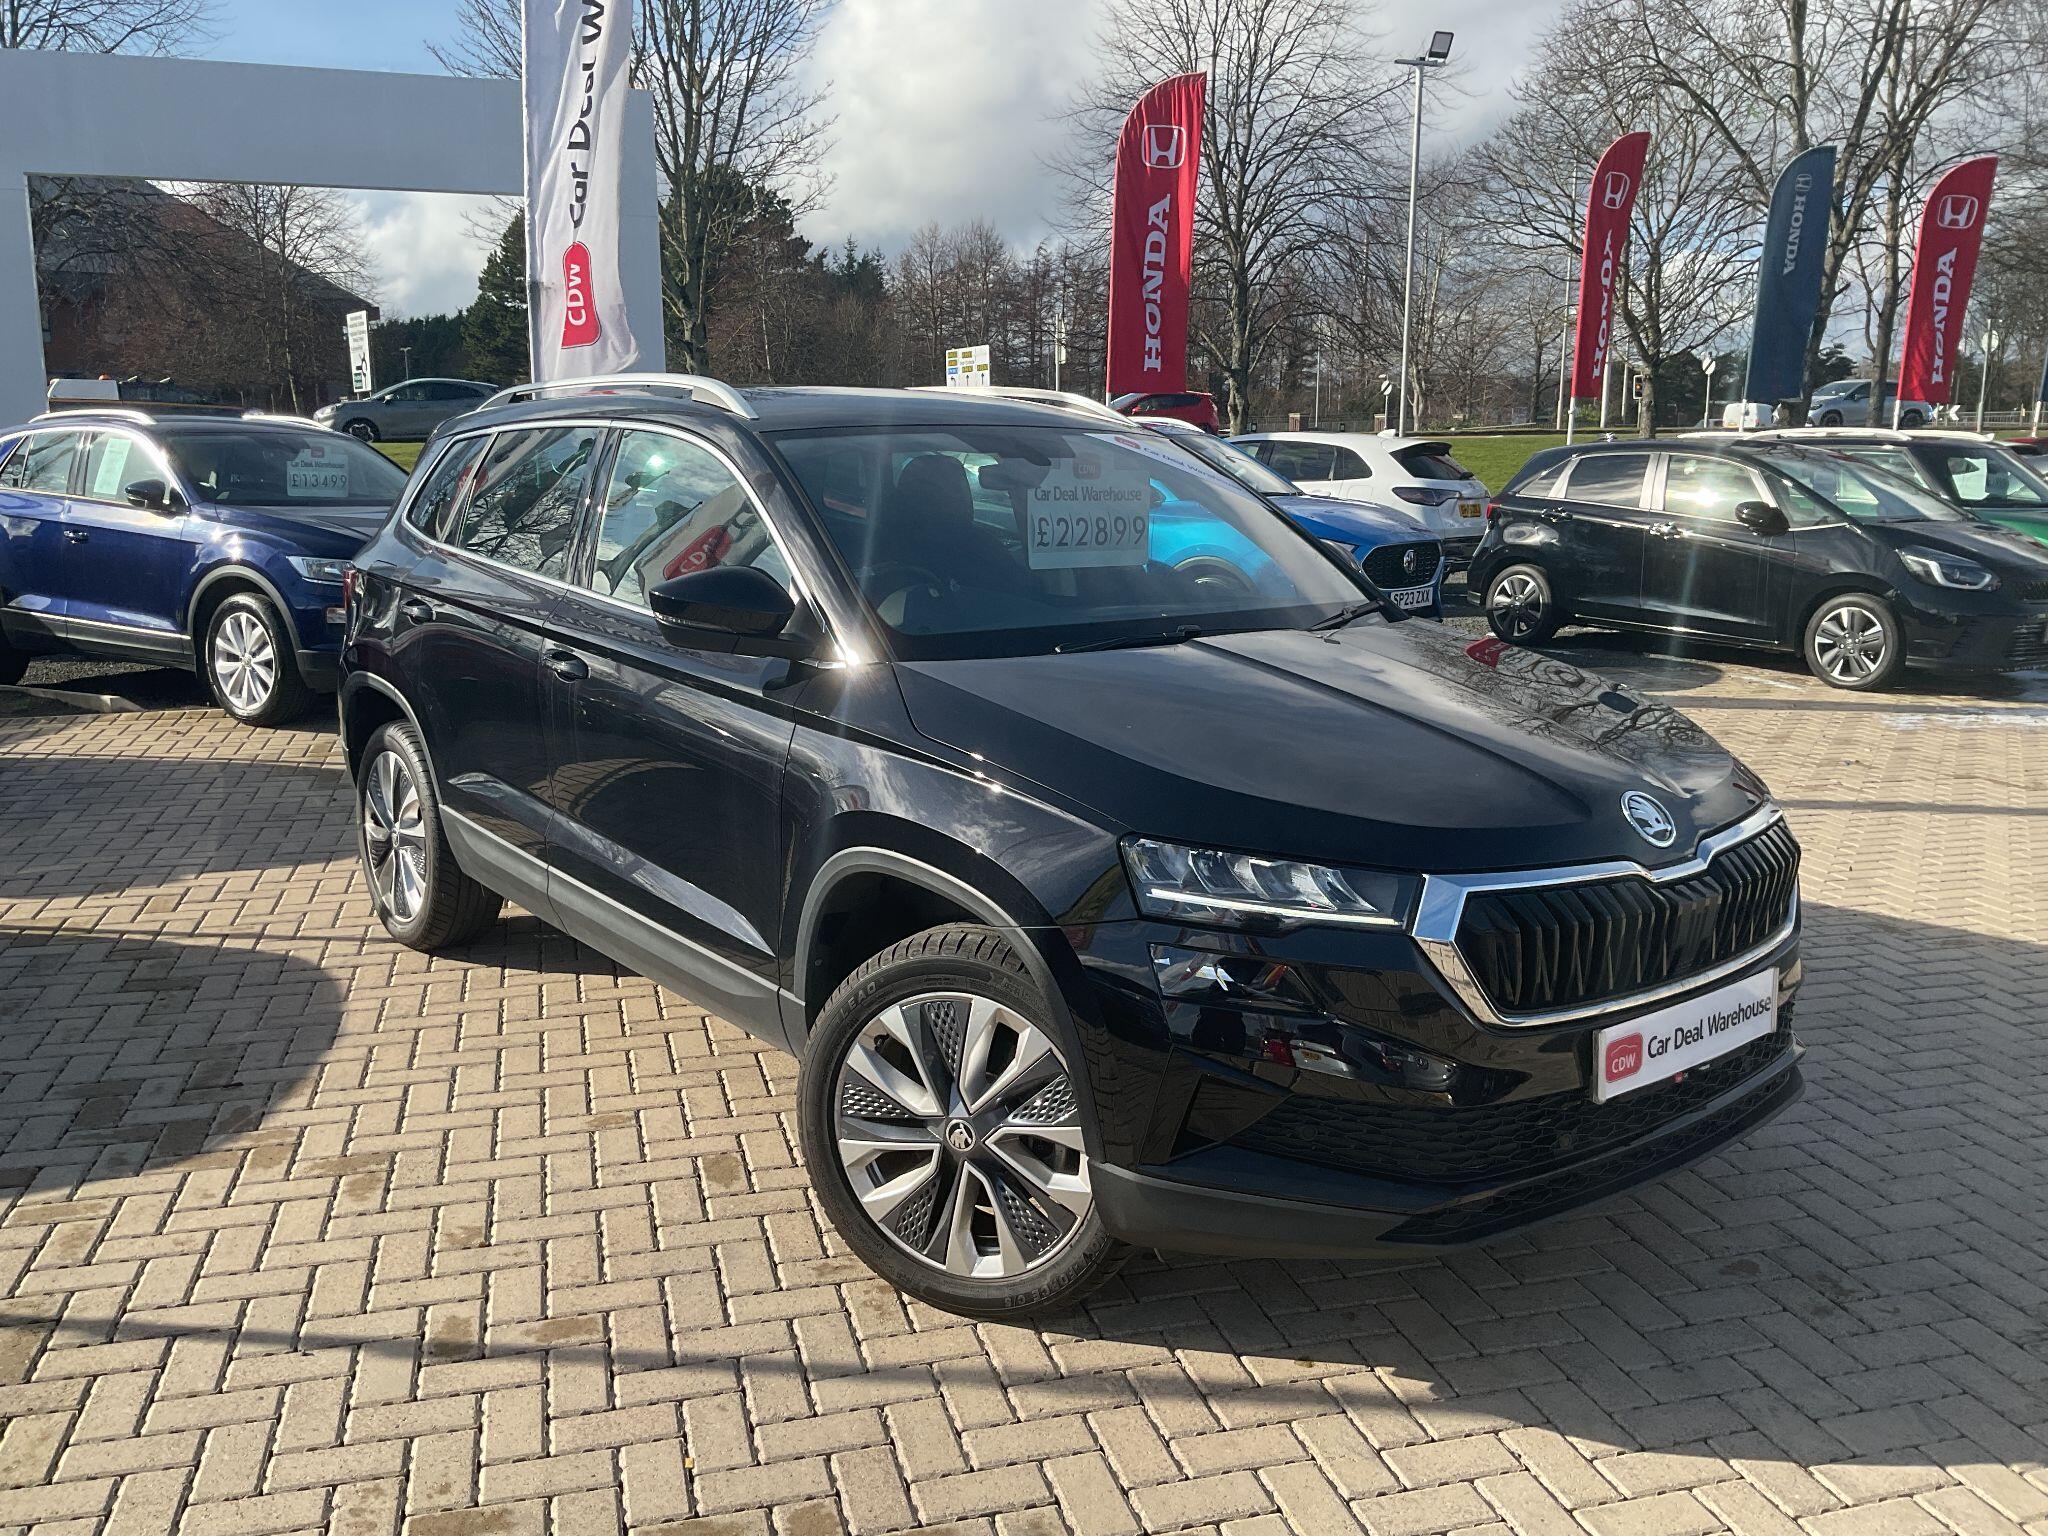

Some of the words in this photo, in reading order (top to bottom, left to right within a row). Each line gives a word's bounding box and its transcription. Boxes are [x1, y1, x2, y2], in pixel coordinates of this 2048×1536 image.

[567, 56, 595, 151] Deal
[569, 162, 589, 230] Car
[1782, 194, 1807, 276] HONDA
[567, 263, 586, 326] CDW
[1143, 194, 1171, 373] HONDA
[1931, 247, 1958, 385] HONDA
[291, 473, 348, 489] £13499
[1034, 486, 1052, 501] Car
[1053, 485, 1079, 501] Deal
[1080, 486, 1143, 502] Warehouse
[1036, 515, 1146, 548] £22899
[1393, 591, 1415, 606] SP23
[1415, 589, 1430, 604] ZXX
[1611, 1053, 1637, 1074] CDW
[1647, 1033, 1671, 1059] Car
[1674, 1019, 1704, 1051] Deal
[1707, 996, 1772, 1037] Warehouse
